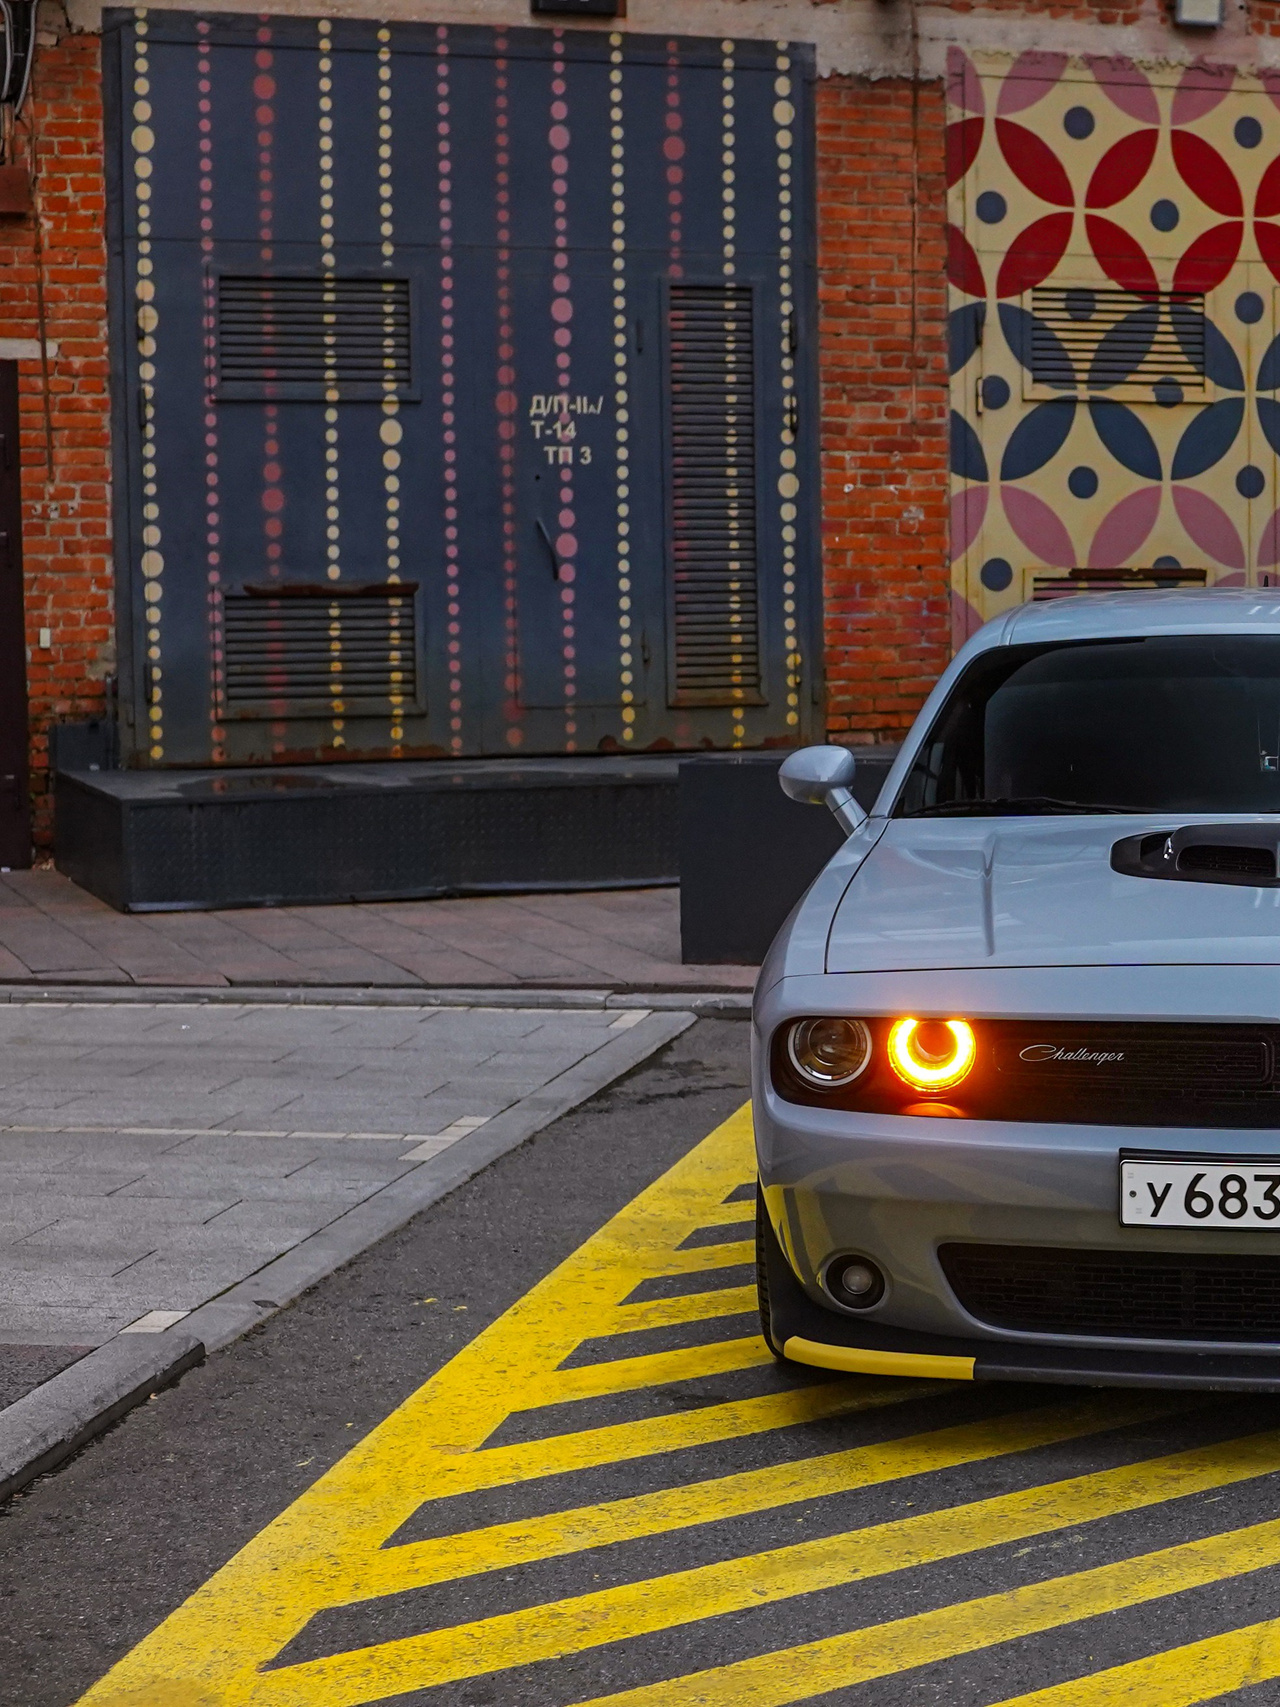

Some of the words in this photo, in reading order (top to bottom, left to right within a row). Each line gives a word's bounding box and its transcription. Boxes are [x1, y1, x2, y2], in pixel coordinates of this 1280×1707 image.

[543, 446, 573, 465] ТП
[580, 446, 592, 465] 3
[1019, 1044, 1125, 1066] Challenger
